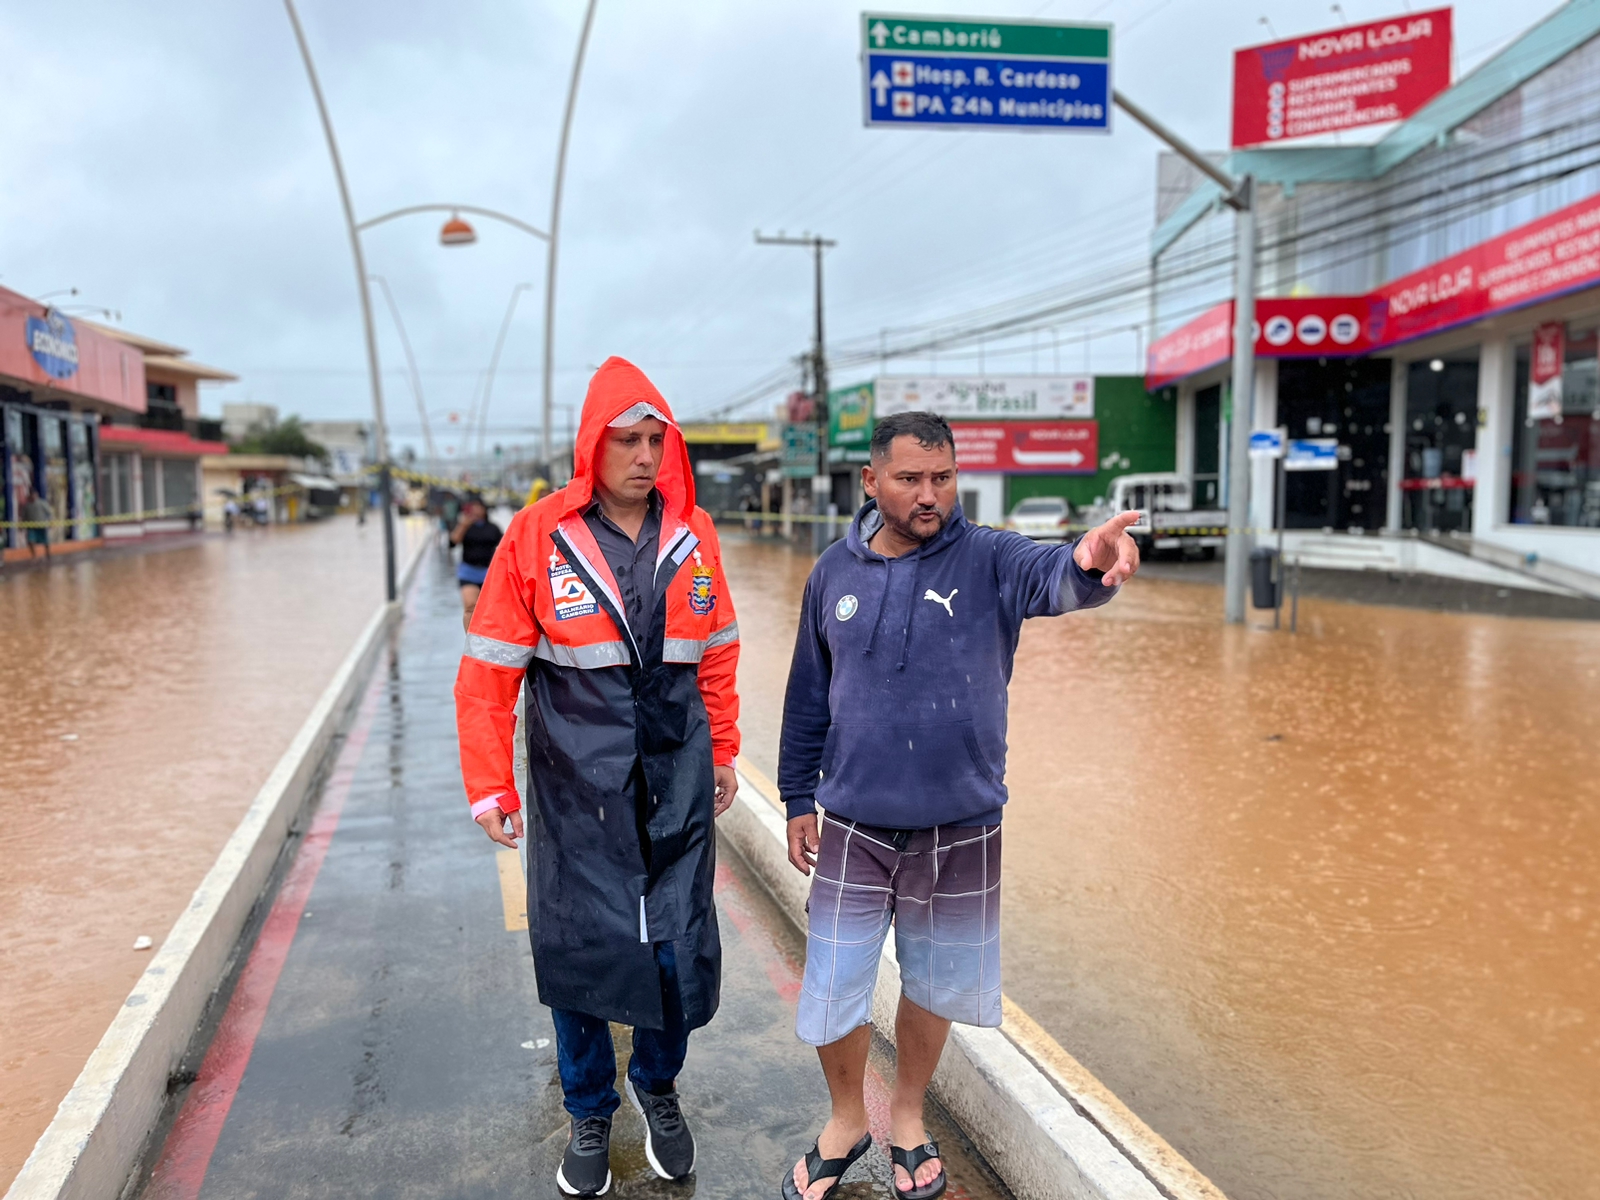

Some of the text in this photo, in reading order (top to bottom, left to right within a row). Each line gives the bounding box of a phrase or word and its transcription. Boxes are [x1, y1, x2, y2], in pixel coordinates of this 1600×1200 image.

[892, 25, 1002, 48] Camboriú
[1298, 31, 1364, 61] NOVA
[1367, 17, 1432, 49] LOJA
[915, 64, 1081, 90] Hosp. R. Cardoso
[1288, 58, 1412, 92] SUPERMERCADOS
[1288, 76, 1398, 106] RESTAURANTES
[916, 95, 946, 115] PA
[950, 96, 994, 116] 24h
[1388, 281, 1429, 318] NOVA
[1429, 265, 1473, 304] LOJA
[976, 390, 1037, 412] Brasil
[1029, 428, 1090, 440] NOVA LOJA
